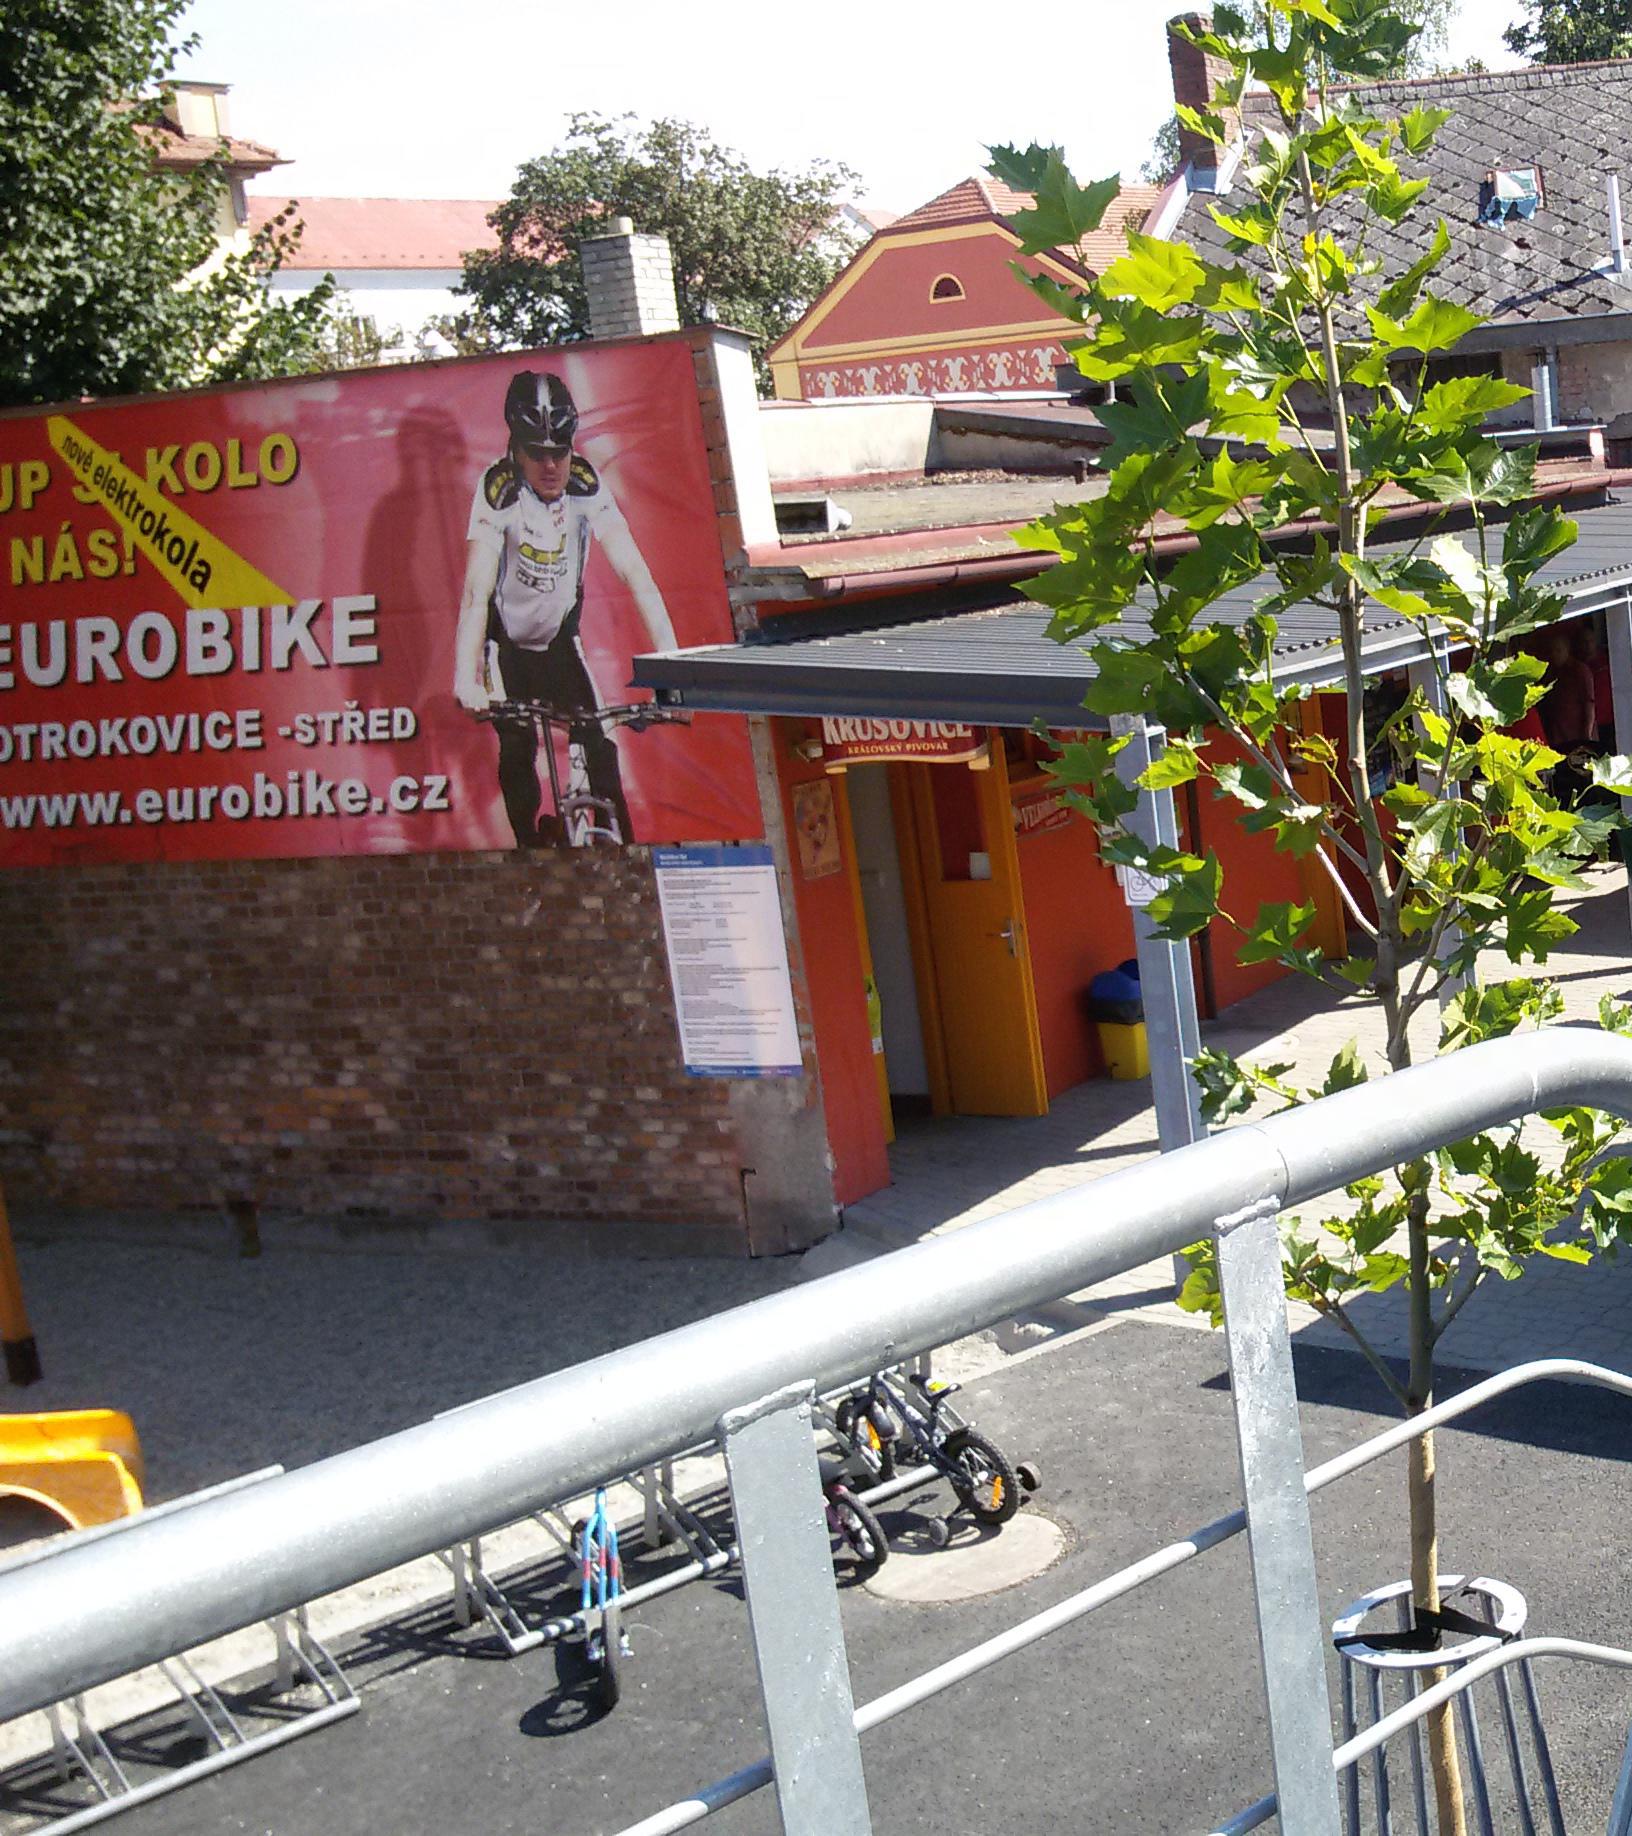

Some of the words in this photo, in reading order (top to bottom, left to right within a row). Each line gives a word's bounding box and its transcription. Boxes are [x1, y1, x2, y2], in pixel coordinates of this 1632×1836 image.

[145, 433, 298, 494] KOLO
[62, 435, 93, 472] nové
[93, 462, 212, 593] elektrokola
[11, 521, 136, 586] NÁS!
[905, 742, 949, 752] PIVOVAR
[0, 769, 450, 830] www.eurobike.cz
